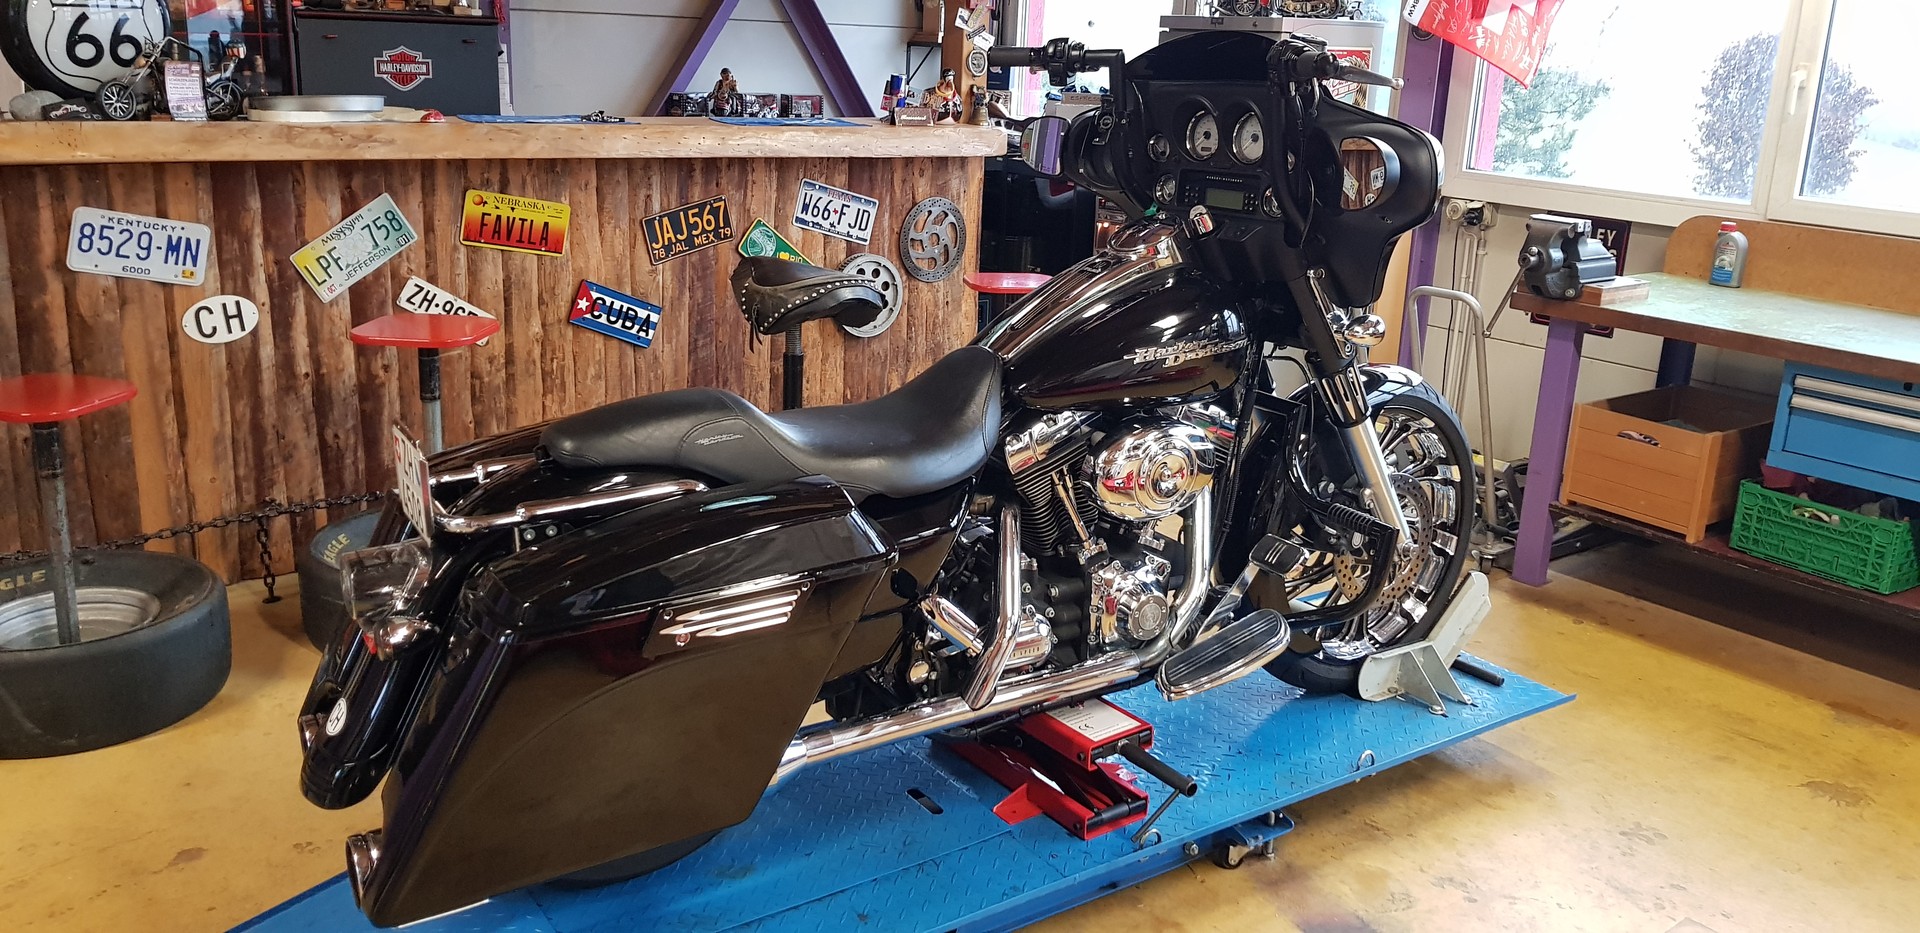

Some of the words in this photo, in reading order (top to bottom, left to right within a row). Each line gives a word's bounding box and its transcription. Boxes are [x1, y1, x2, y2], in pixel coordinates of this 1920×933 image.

[66, 11, 143, 68] 66
[390, 51, 416, 61] MOTOR
[379, 62, 427, 73] HARLEY-DAVIDSON
[391, 74, 417, 86] CYCLES
[493, 196, 546, 211] NEBRASKA
[800, 192, 834, 221] W66
[837, 203, 871, 231] FJD
[827, 189, 853, 203] TEXAS
[107, 216, 178, 233] KENTUCKY
[479, 212, 550, 247] FAVILA
[651, 201, 725, 249] JAJ567
[77, 222, 202, 268] 8529-MN
[304, 246, 344, 287] LPF
[361, 209, 403, 248] 758
[653, 248, 666, 260] 78
[670, 241, 689, 255] JAL
[694, 232, 717, 247] MEX
[718, 227, 731, 238] 79
[344, 245, 391, 281] JEFFERSON
[195, 300, 246, 338] CH
[590, 297, 651, 337] CUBA
